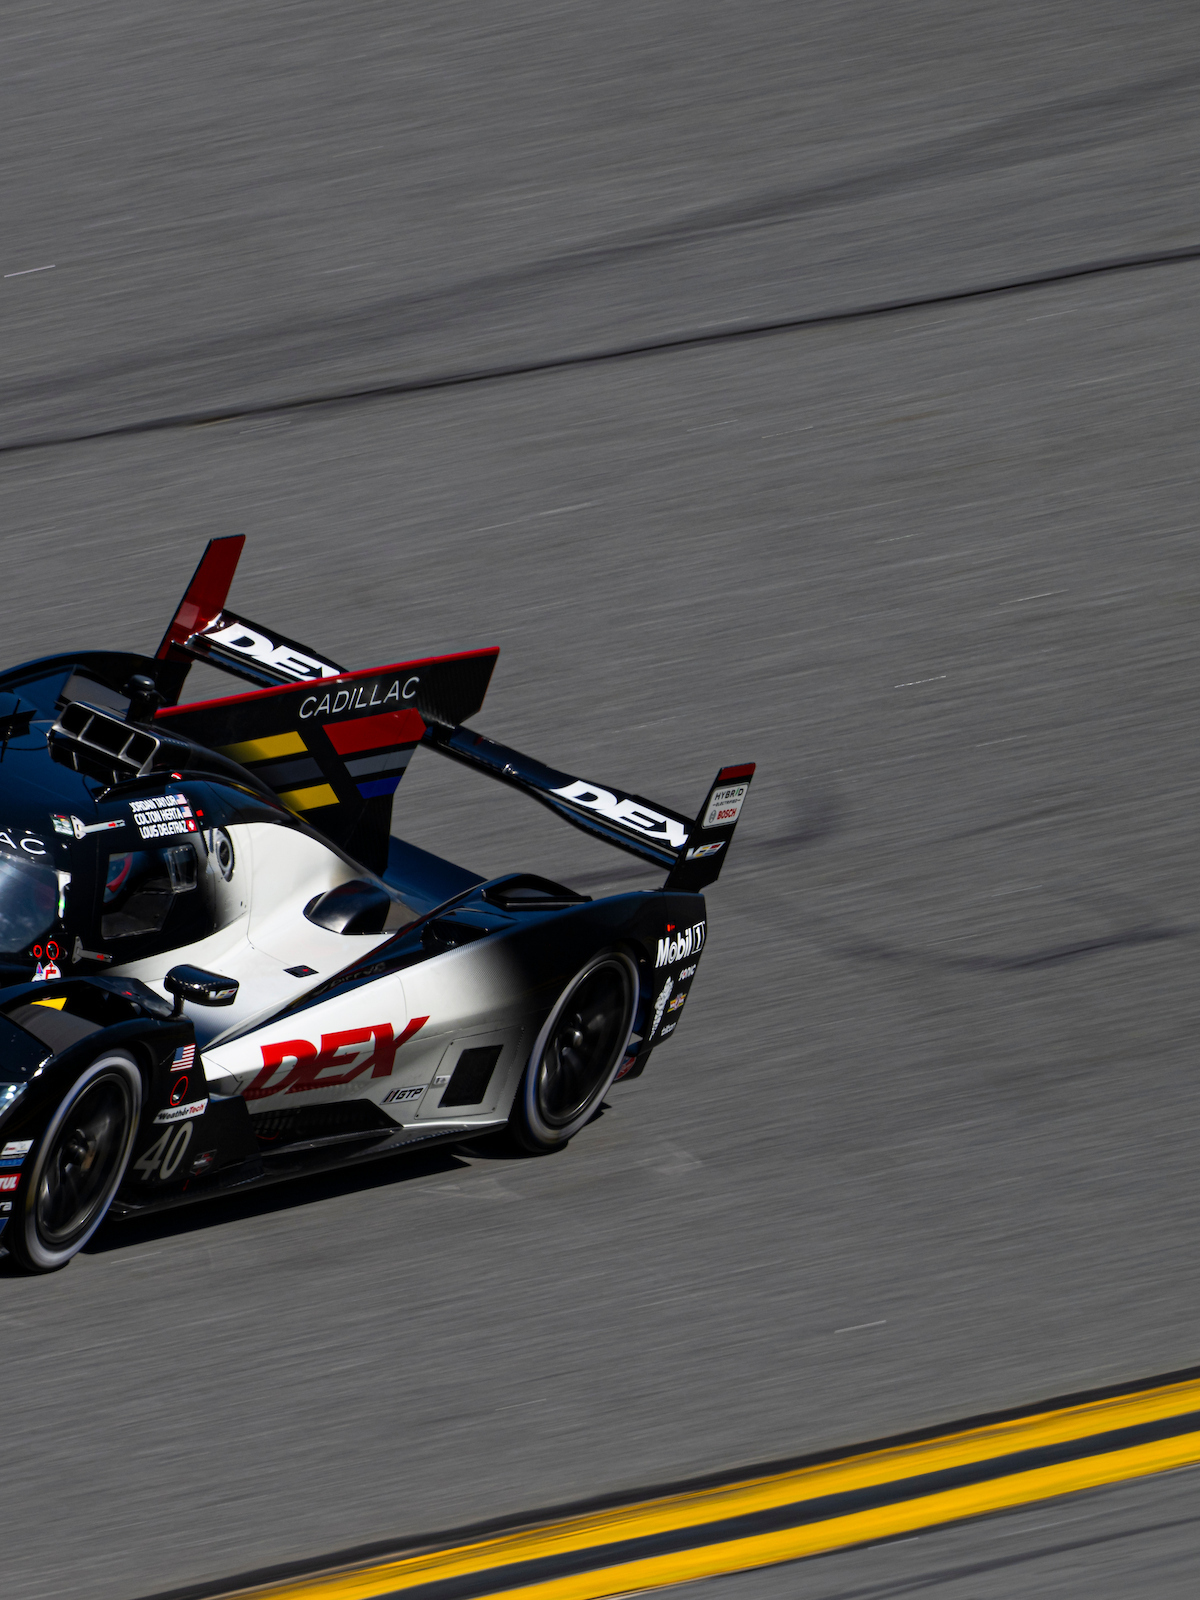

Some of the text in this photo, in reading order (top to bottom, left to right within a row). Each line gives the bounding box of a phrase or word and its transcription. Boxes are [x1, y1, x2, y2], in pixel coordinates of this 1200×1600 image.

[299, 676, 420, 719] CADILLAC
[129, 794, 178, 812] JORDAN TAYLOR
[714, 788, 744, 801] HYBRID
[134, 807, 184, 825] COLTON HERTA
[717, 808, 737, 820] BOSCH
[139, 820, 189, 839] LOUIS DELETRAZ
[655, 927, 693, 968] Mobil
[242, 1015, 430, 1100] DEX
[395, 1087, 424, 1100] GTP
[158, 1103, 205, 1120] WeatherTech
[133, 1121, 193, 1180] 40
